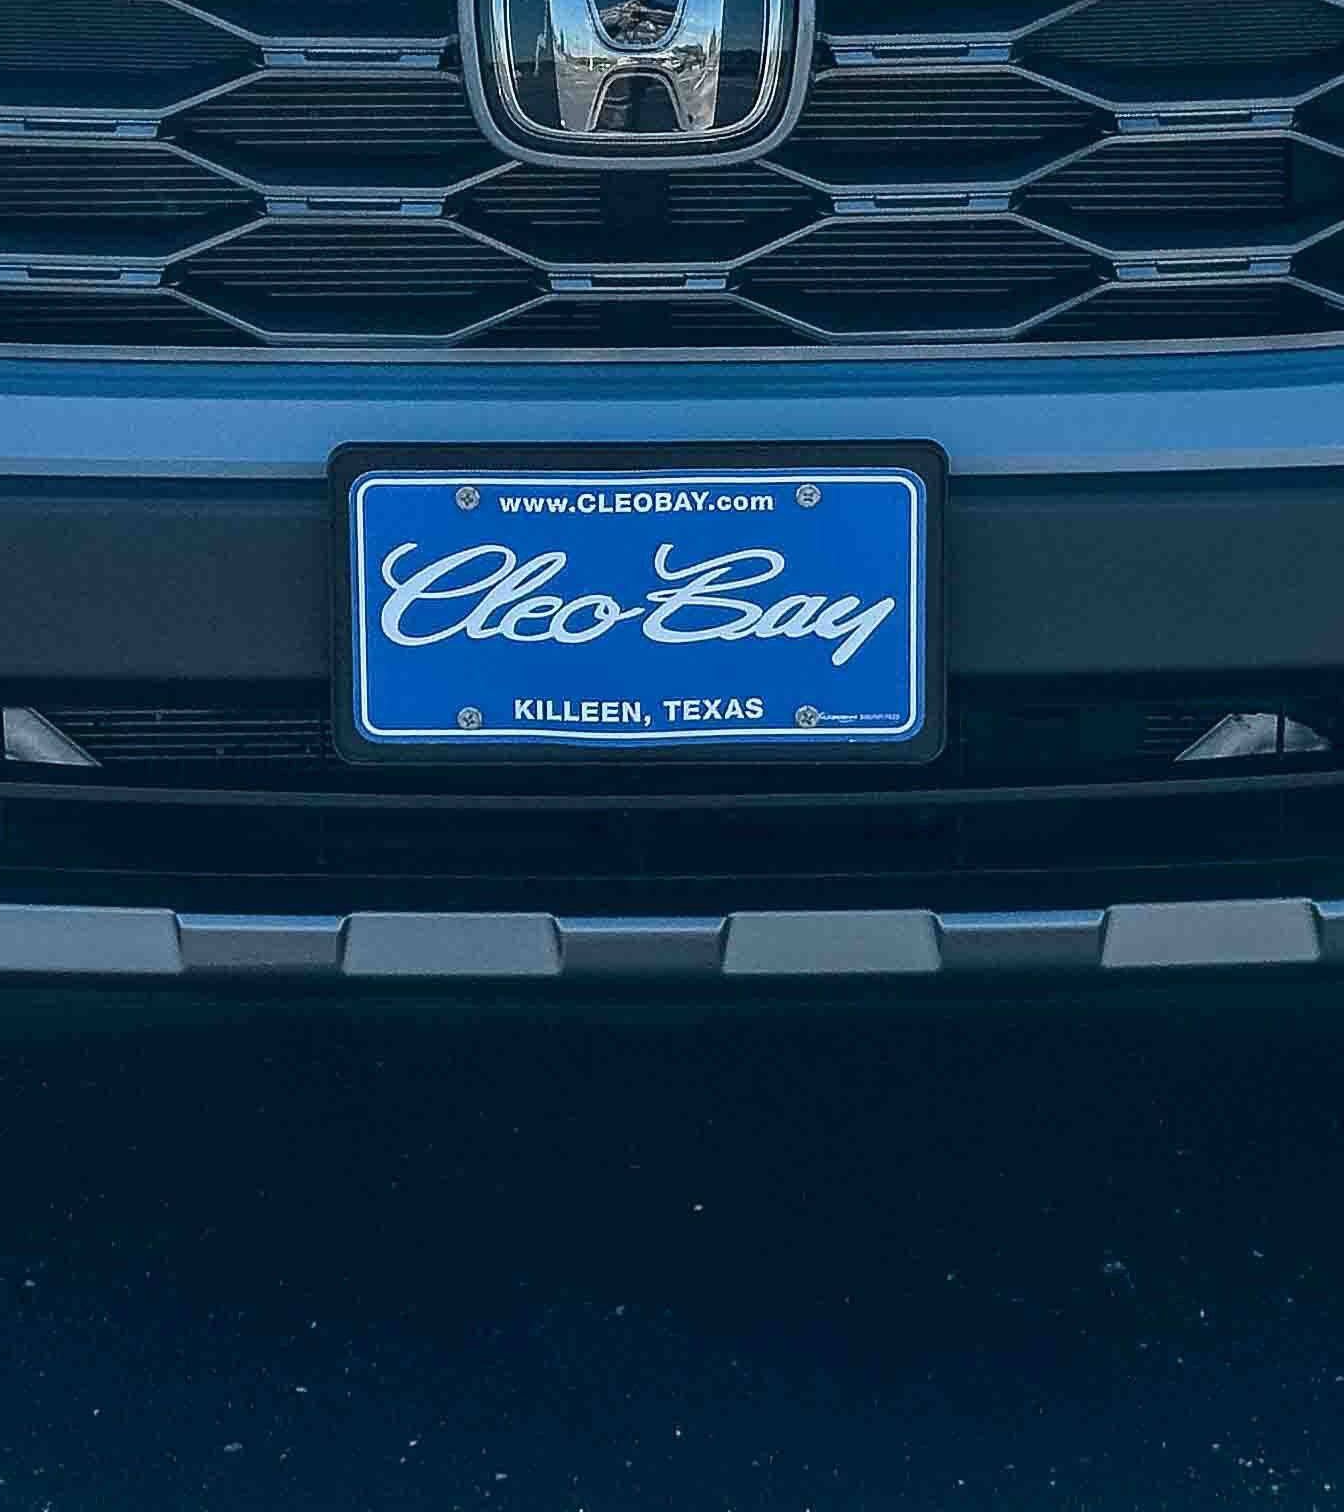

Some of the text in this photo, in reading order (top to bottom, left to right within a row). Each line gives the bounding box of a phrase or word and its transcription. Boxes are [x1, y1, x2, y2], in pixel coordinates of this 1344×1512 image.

[499, 491, 775, 513] www.CLEOBAY.com
[380, 542, 895, 666] Cleo Bay
[514, 698, 764, 726] KILLEEN, TEXAS
